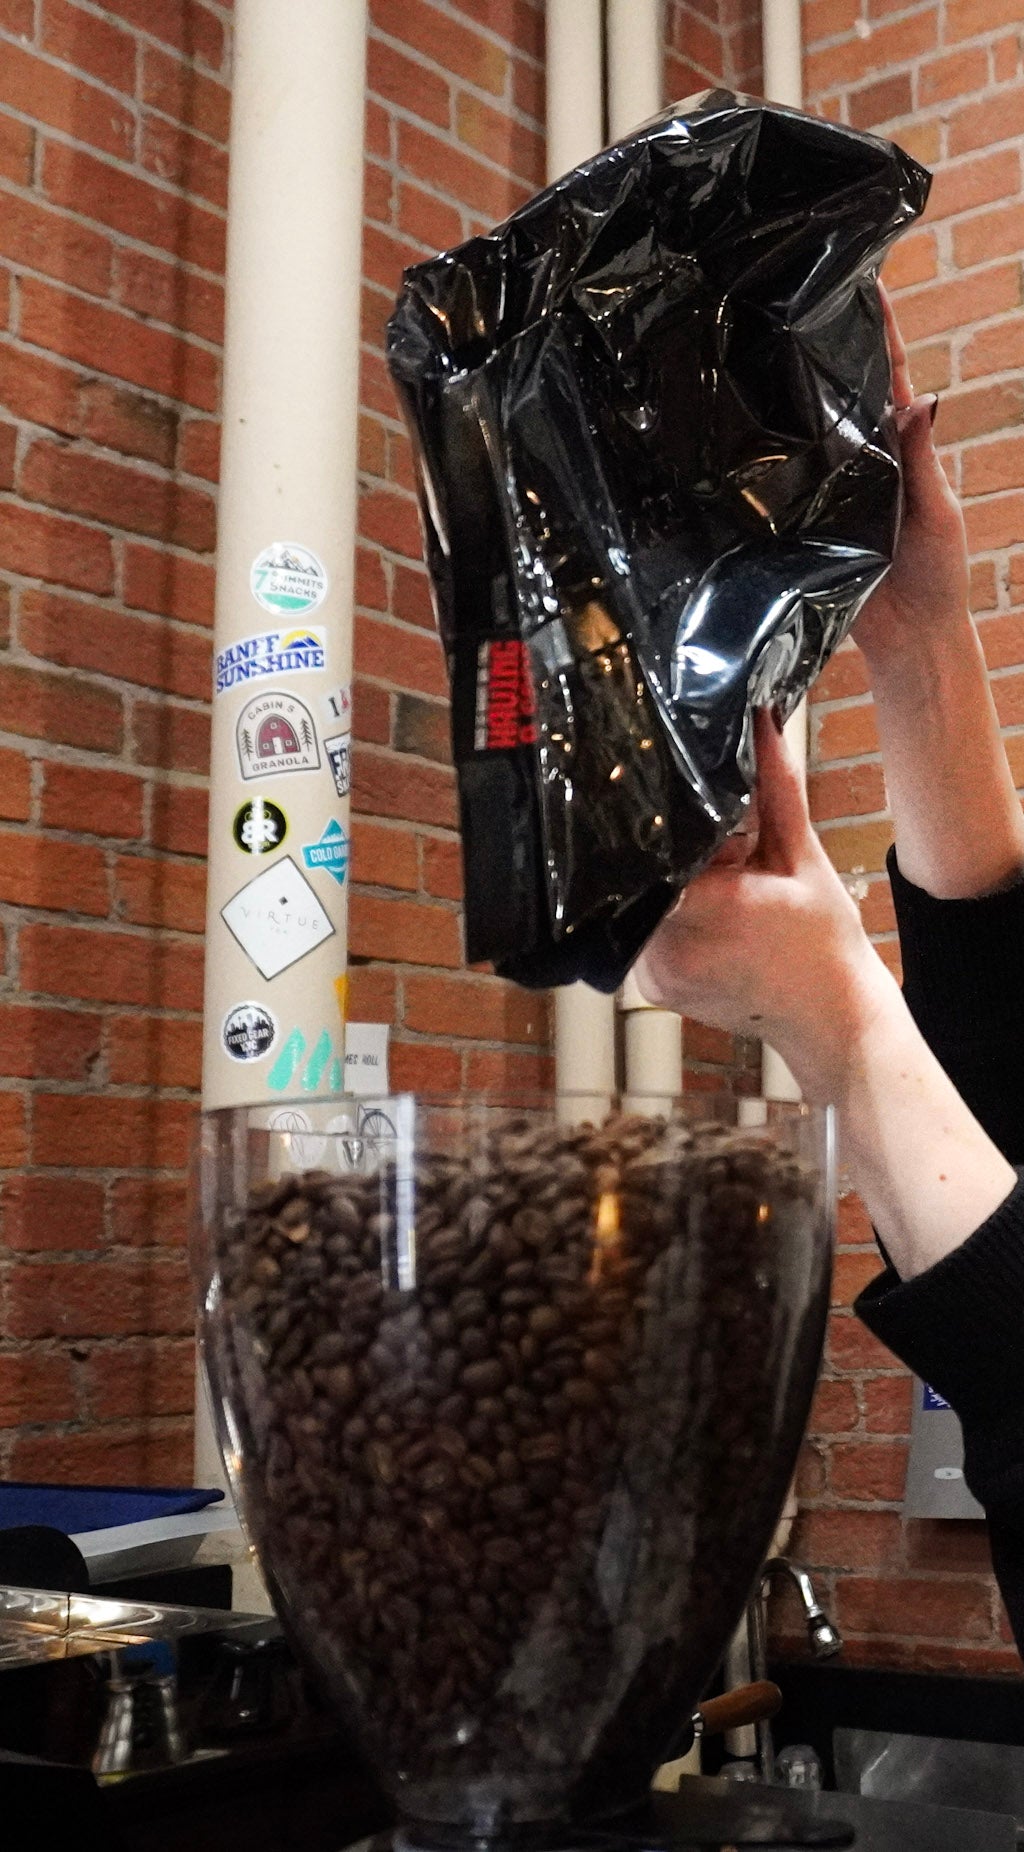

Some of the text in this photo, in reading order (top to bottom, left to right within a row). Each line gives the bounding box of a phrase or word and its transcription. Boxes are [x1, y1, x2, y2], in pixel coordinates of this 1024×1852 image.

[255, 569, 268, 590] 7
[270, 582, 317, 599] SNACKS
[216, 634, 280, 673] BANFF
[217, 649, 324, 694] SUNSHINE
[247, 700, 283, 720] CABIN
[252, 756, 309, 772] GRANOLA
[310, 847, 333, 863] COLD
[240, 906, 320, 930] VIRTUE
[228, 1032, 247, 1045] FIXED
